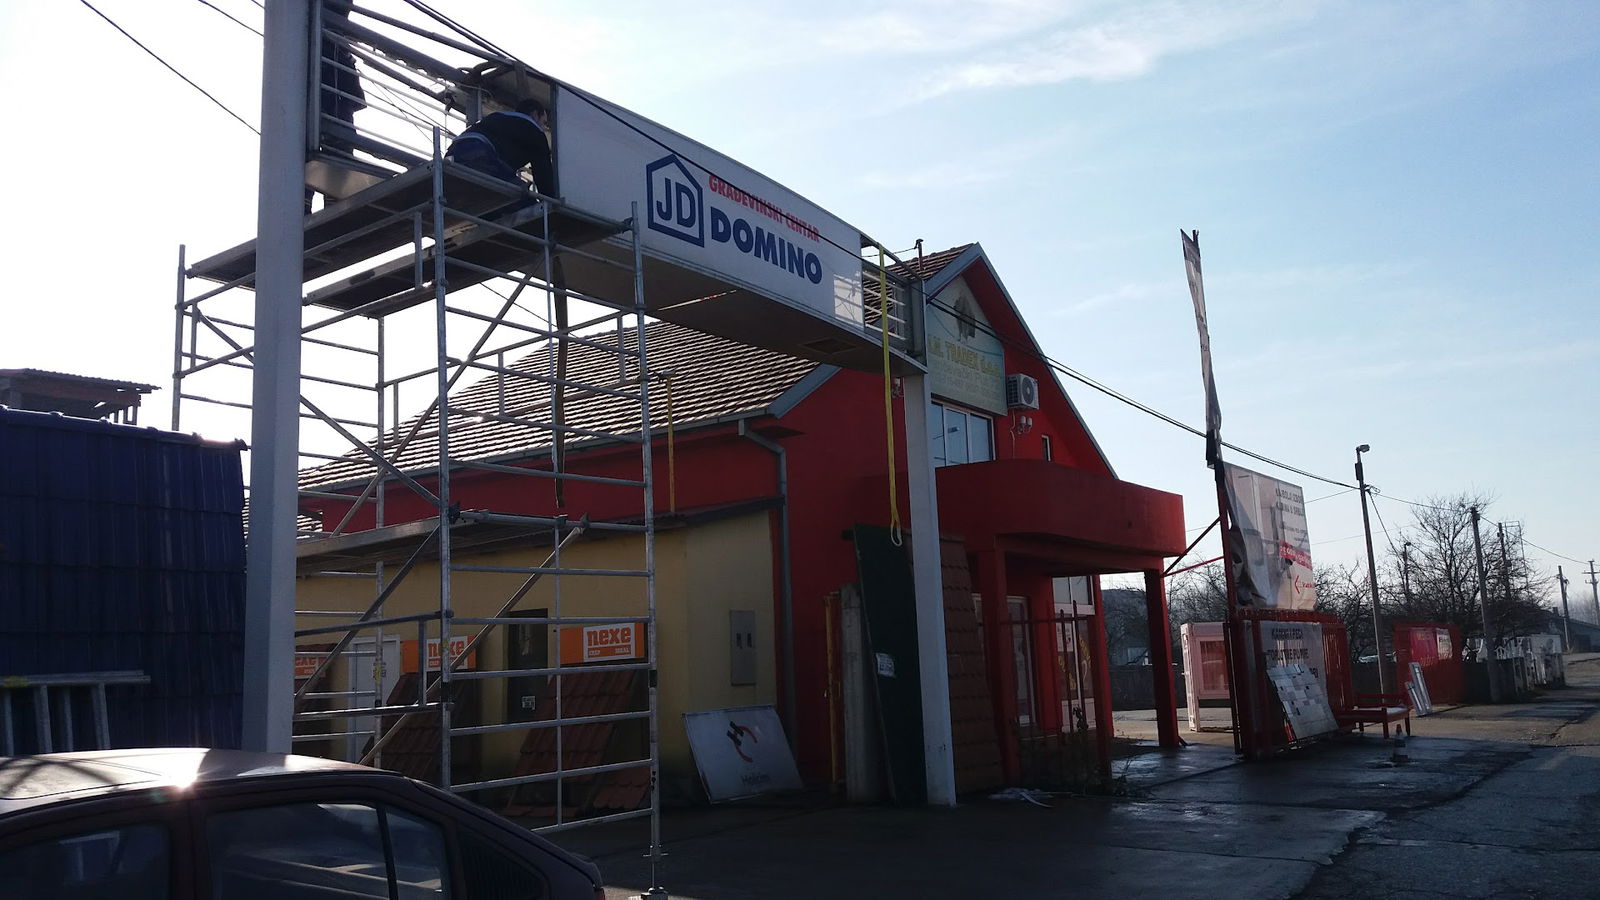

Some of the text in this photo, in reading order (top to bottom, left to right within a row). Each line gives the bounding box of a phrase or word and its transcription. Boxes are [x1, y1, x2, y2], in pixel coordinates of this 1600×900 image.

[656, 177, 696, 228] JD
[710, 207, 823, 285] DOMINO
[784, 212, 821, 243] CENTAR
[587, 627, 631, 646] nexe
